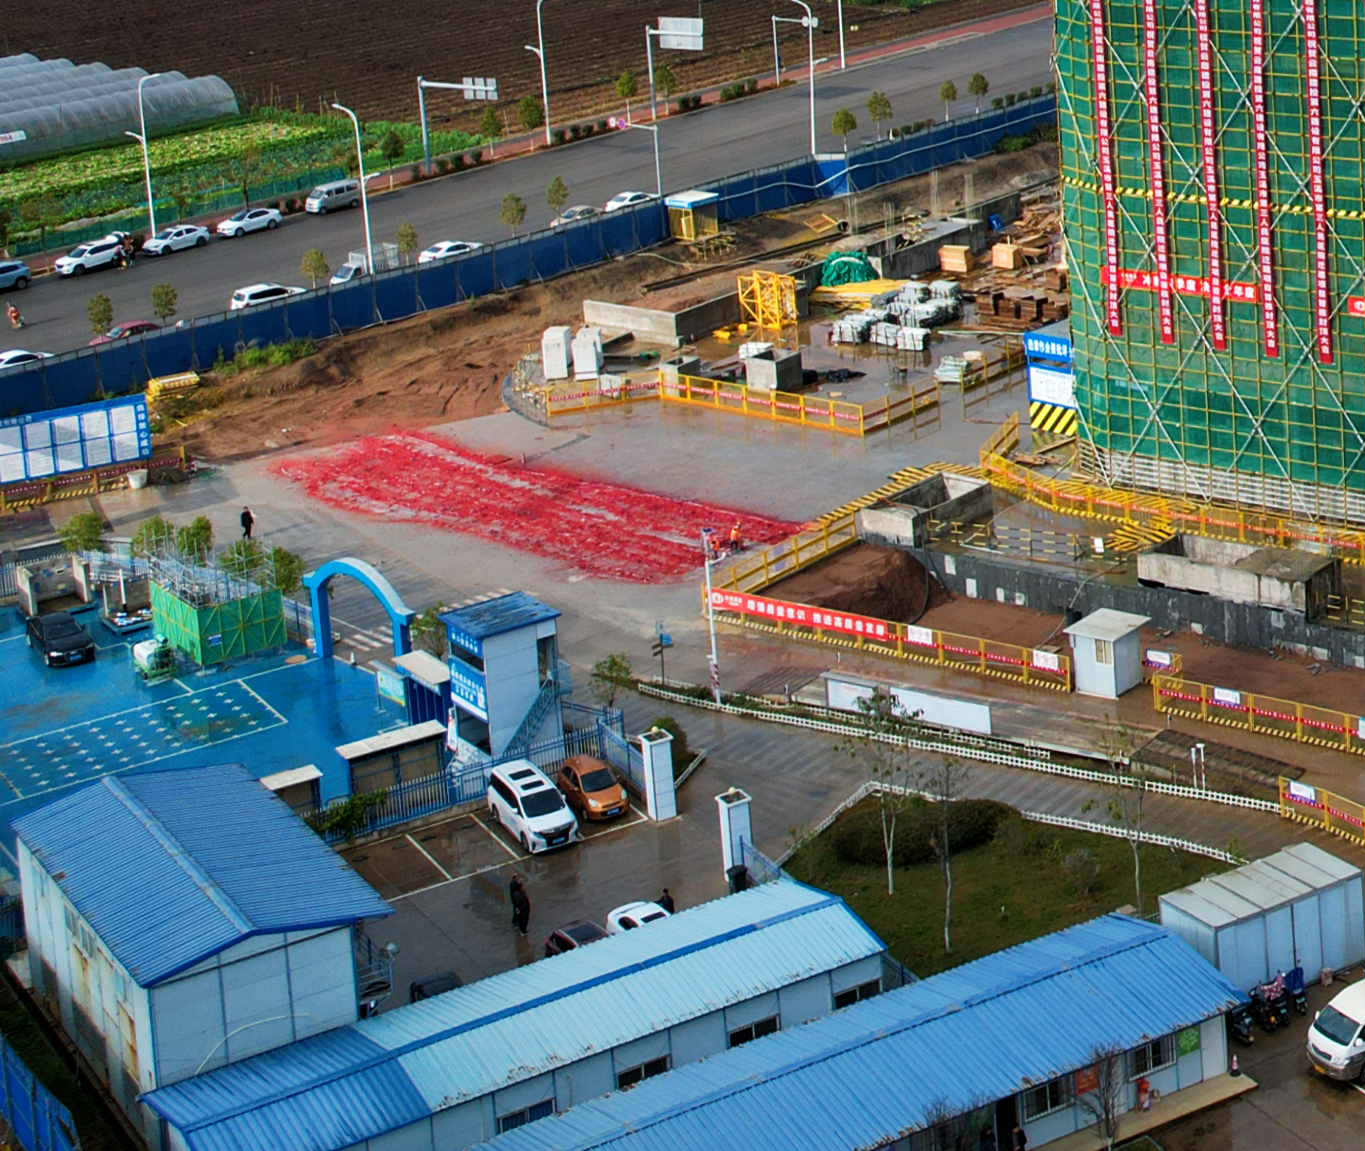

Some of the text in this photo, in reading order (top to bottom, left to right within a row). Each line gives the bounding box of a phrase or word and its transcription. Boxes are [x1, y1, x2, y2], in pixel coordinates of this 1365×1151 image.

[747, 599, 806, 621] 增强质量意识
[812, 612, 885, 637] 推进高质量发展
